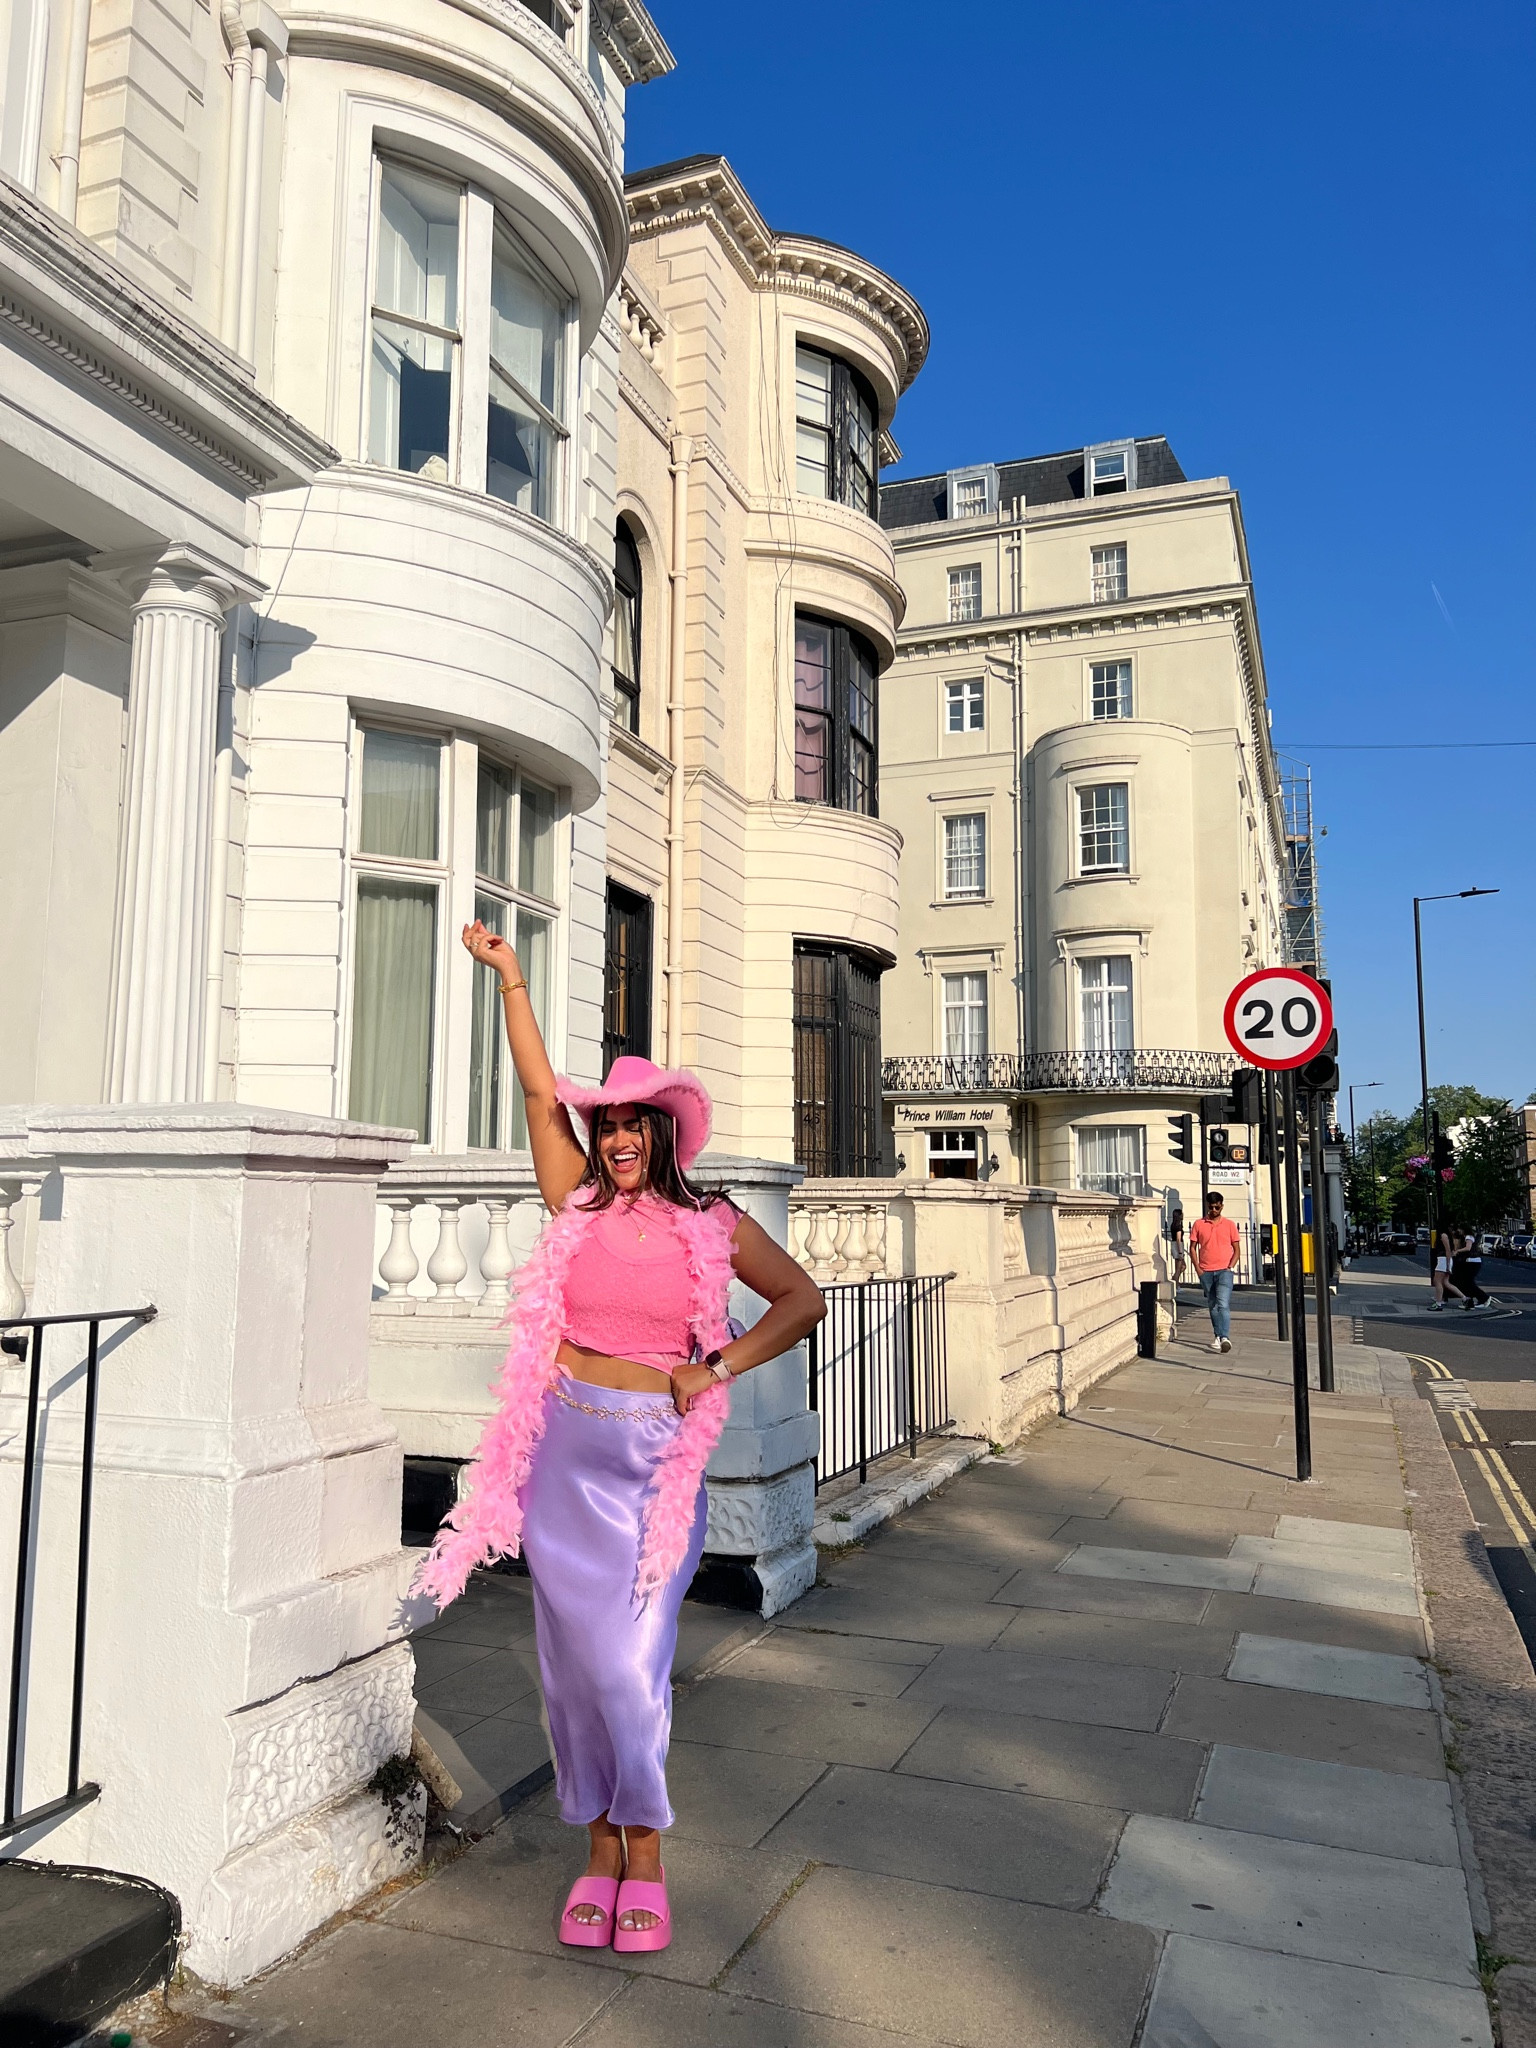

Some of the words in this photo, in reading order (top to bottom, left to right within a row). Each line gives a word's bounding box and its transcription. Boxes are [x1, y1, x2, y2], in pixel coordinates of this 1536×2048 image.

[1242, 997, 1316, 1039] 20
[903, 1111, 930, 1121] Prince
[935, 1110, 965, 1121] William
[970, 1109, 993, 1121] Hotel
[1233, 1149, 1244, 1159] 02
